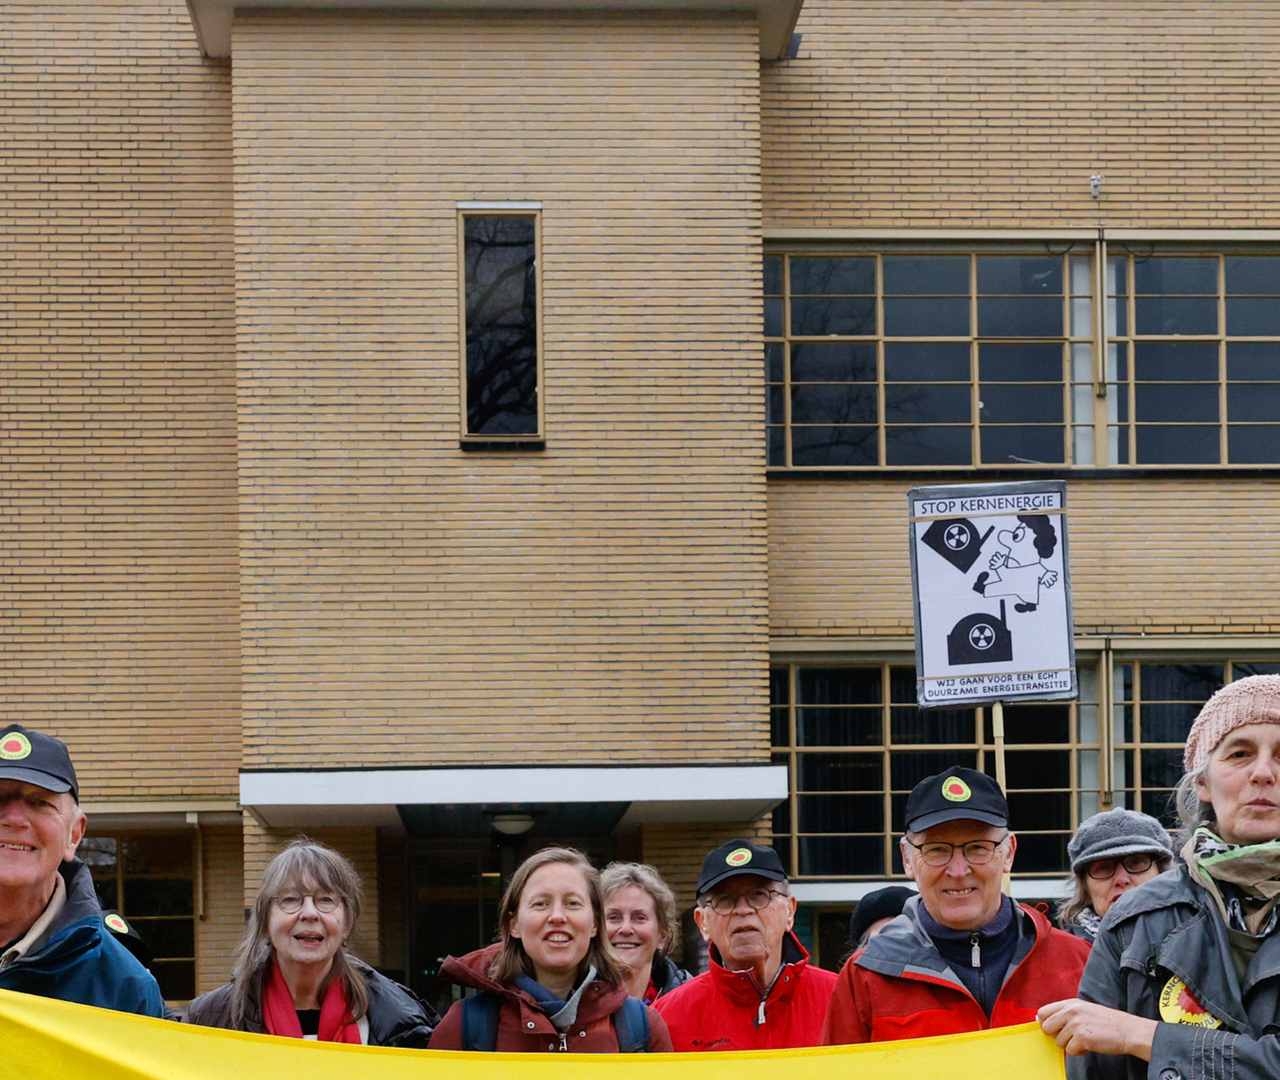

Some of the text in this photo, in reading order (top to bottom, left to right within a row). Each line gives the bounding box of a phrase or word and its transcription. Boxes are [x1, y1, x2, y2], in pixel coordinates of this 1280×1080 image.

[921, 495, 1054, 514] STOP KERNENERGIE
[936, 671, 1059, 688] WIJ GAAN VOOR EEN ECHT
[928, 680, 1069, 697] DUURZAME ENERGIETRANSITIE
